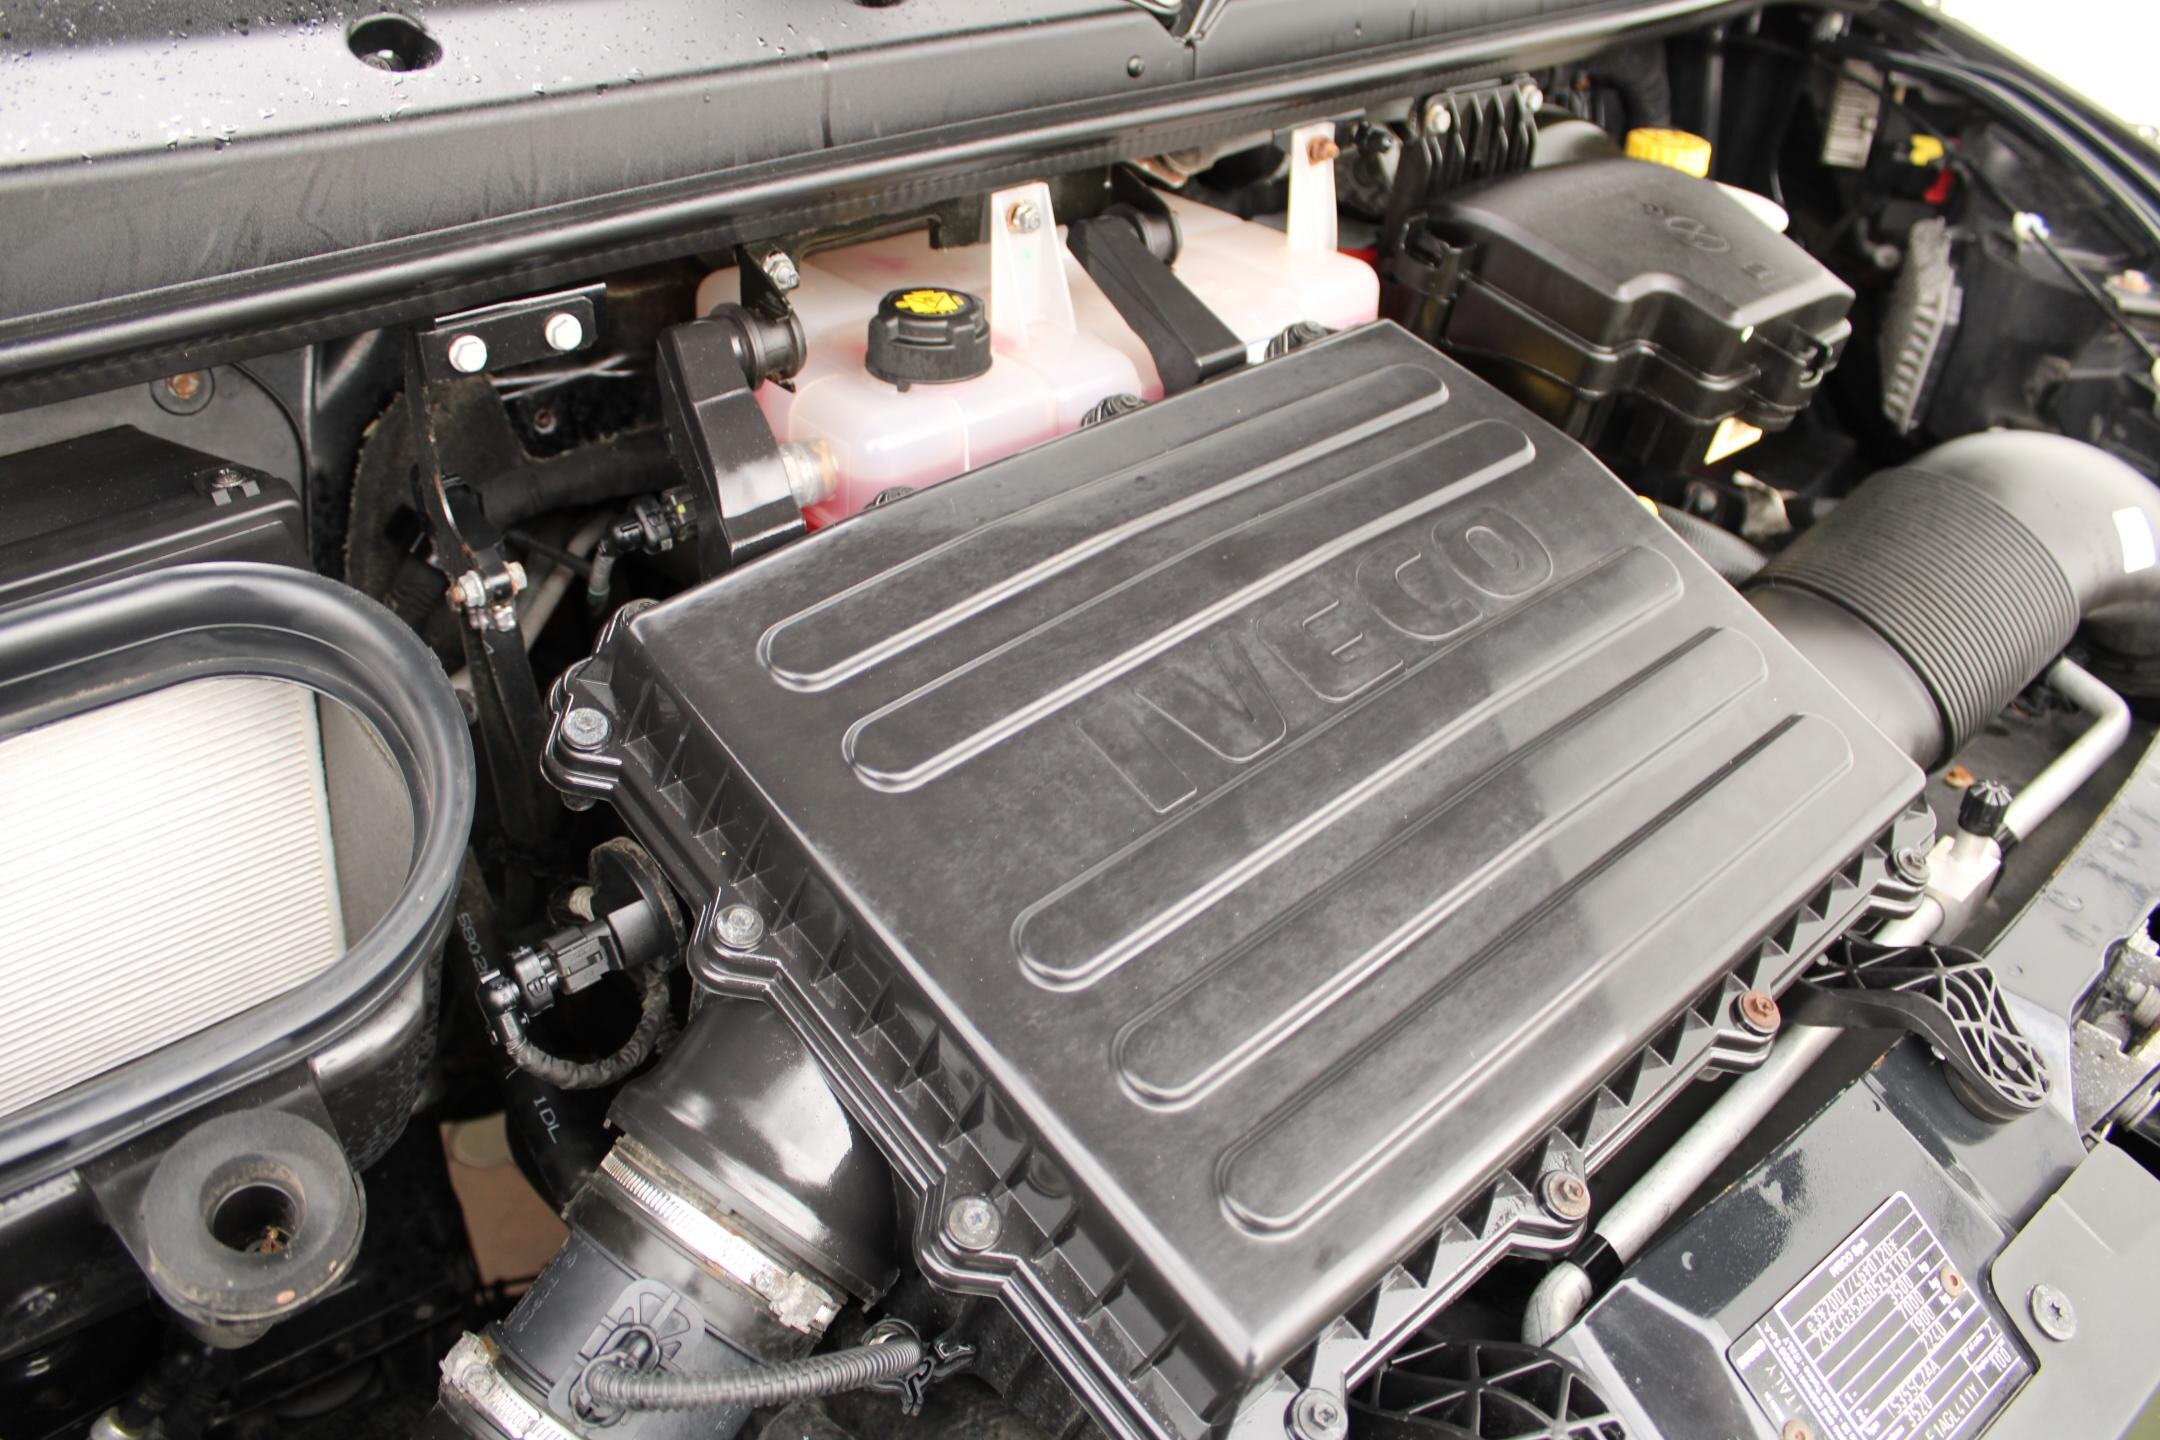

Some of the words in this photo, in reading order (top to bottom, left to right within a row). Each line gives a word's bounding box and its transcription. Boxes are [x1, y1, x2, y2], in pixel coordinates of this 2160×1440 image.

[1075, 506, 1554, 813] IVECO
[454, 910, 489, 976] 5802
[1886, 1273, 1915, 1305] 3500
[1897, 1289, 1925, 1320] 7000
[1909, 1304, 1936, 1334] 1900
[1919, 1321, 1947, 1353] 2240
[1989, 1346, 2013, 1372] 100
[1763, 1365, 1803, 1413] ITALY
[1903, 1392, 1933, 1428] 3520
